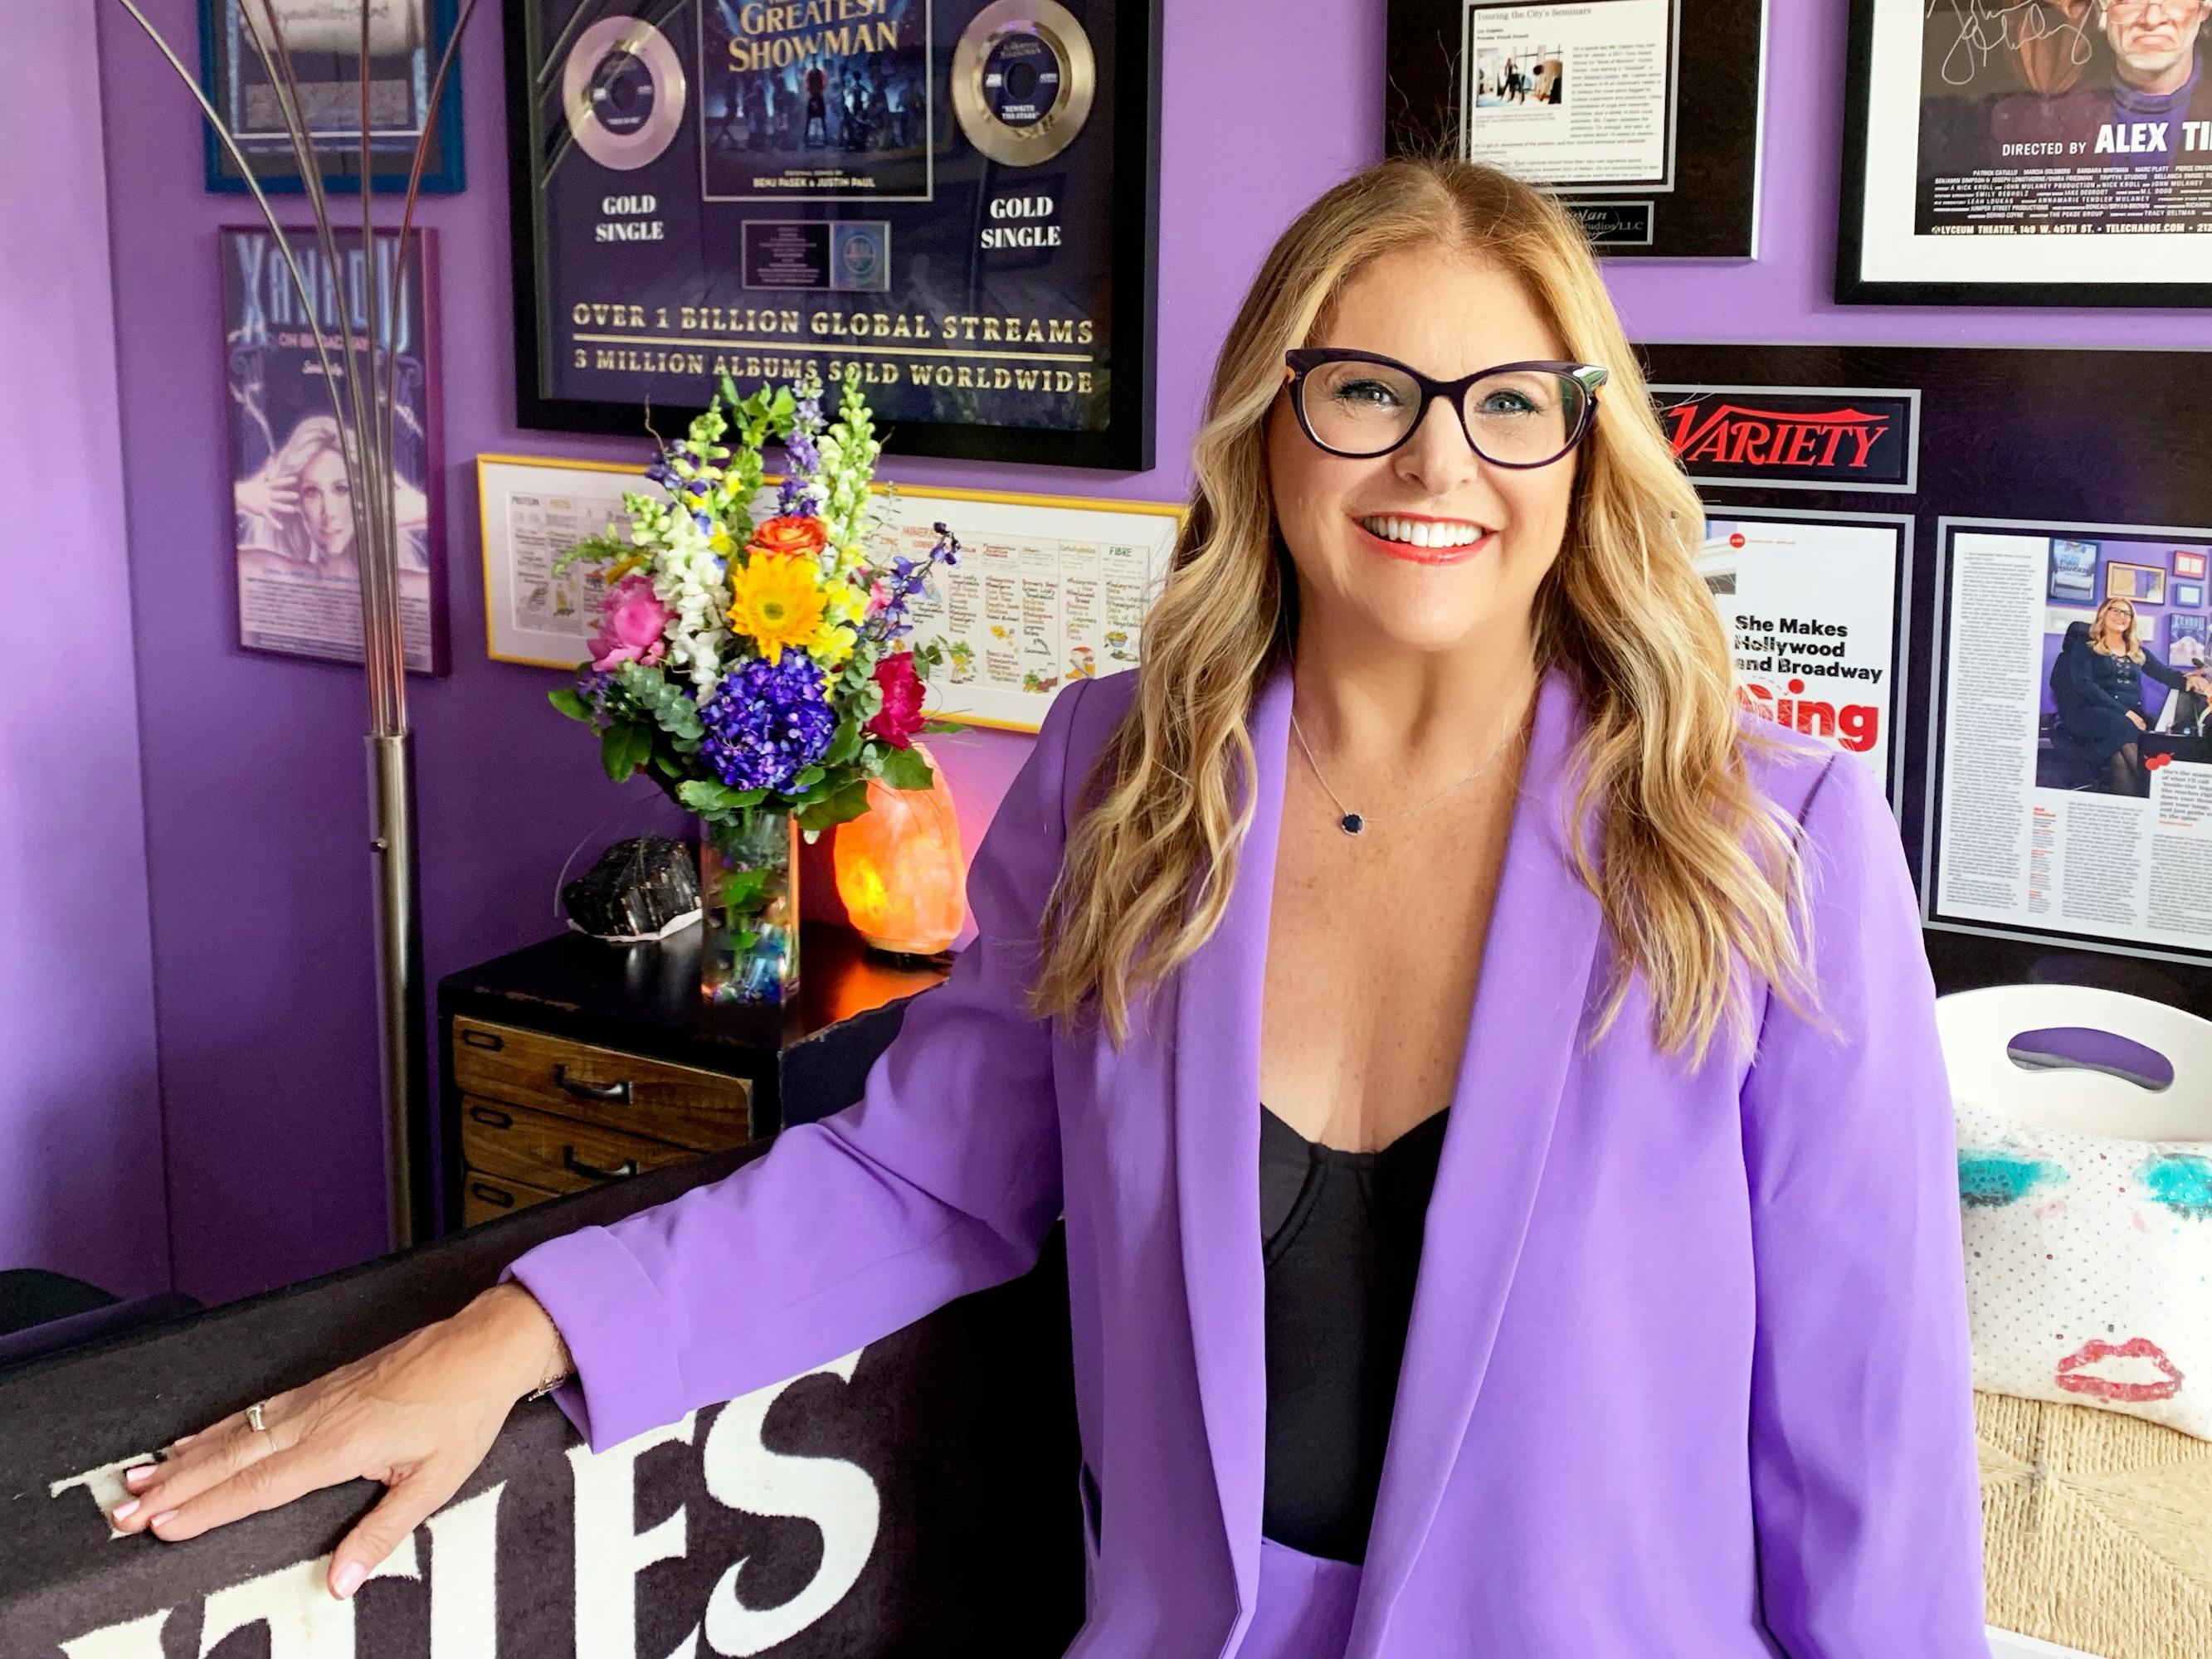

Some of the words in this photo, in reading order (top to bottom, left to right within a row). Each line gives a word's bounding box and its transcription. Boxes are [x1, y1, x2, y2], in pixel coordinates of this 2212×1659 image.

[1512, 10, 1524, 18] the
[1527, 9, 1549, 18] City's
[1552, 7, 1591, 17] Seminars
[728, 21, 899, 72] SHOWMAN
[2002, 143, 2063, 156] DIRECTED
[2069, 142, 2087, 154] BY
[2094, 121, 2169, 153] ALEX
[2182, 121, 2212, 151] TI
[602, 196, 656, 215] GOLD
[989, 197, 1054, 220] GOLD
[596, 221, 664, 242] SINGLE
[981, 225, 1061, 249] SINGLE
[1619, 221, 1644, 231] LLC
[1978, 226, 2017, 234] THEATRE,
[2040, 225, 2051, 233] W.
[2081, 225, 2094, 233] ST.
[2106, 224, 2185, 233] TELECHARGE.COM
[236, 236, 408, 353] XANADU
[572, 304, 646, 328] OVER
[655, 309, 669, 328] 1
[681, 308, 800, 333] BILLION
[811, 312, 930, 338] GLOBAL
[943, 316, 1094, 344] STREAMS
[574, 349, 587, 369] 3
[597, 350, 704, 374] MILLION
[713, 355, 818, 380] ALBUMS
[828, 360, 899, 384] SOLD
[910, 364, 1093, 392] WORLDWIDE
[1668, 405, 1889, 468] VARIETY
[1109, 547, 1133, 557] FIBRE
[1735, 615, 1774, 632] She
[1780, 618, 1848, 637] Makes
[1734, 635, 1845, 657] Hollywood
[1736, 657, 1772, 671] and
[1779, 658, 1883, 684] Broadway
